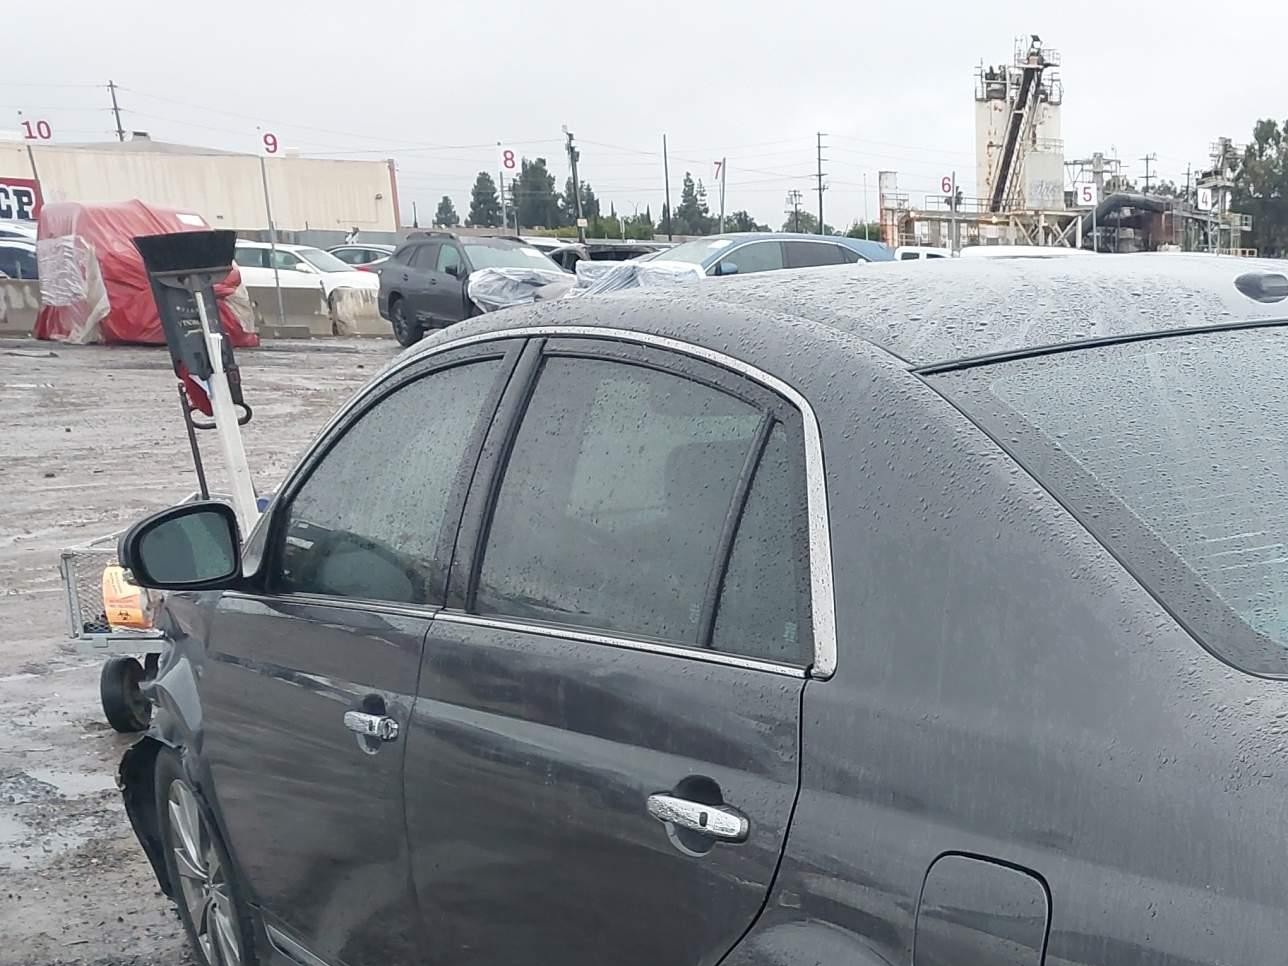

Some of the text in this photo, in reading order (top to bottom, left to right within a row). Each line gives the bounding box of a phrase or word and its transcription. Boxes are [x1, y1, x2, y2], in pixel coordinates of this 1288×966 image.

[21, 120, 52, 140] 10
[263, 133, 279, 153] 9
[503, 150, 516, 169] 8
[713, 161, 722, 180] 7
[941, 176, 951, 193] 6
[1082, 186, 1092, 203] 5
[1201, 194, 1209, 209] 4
